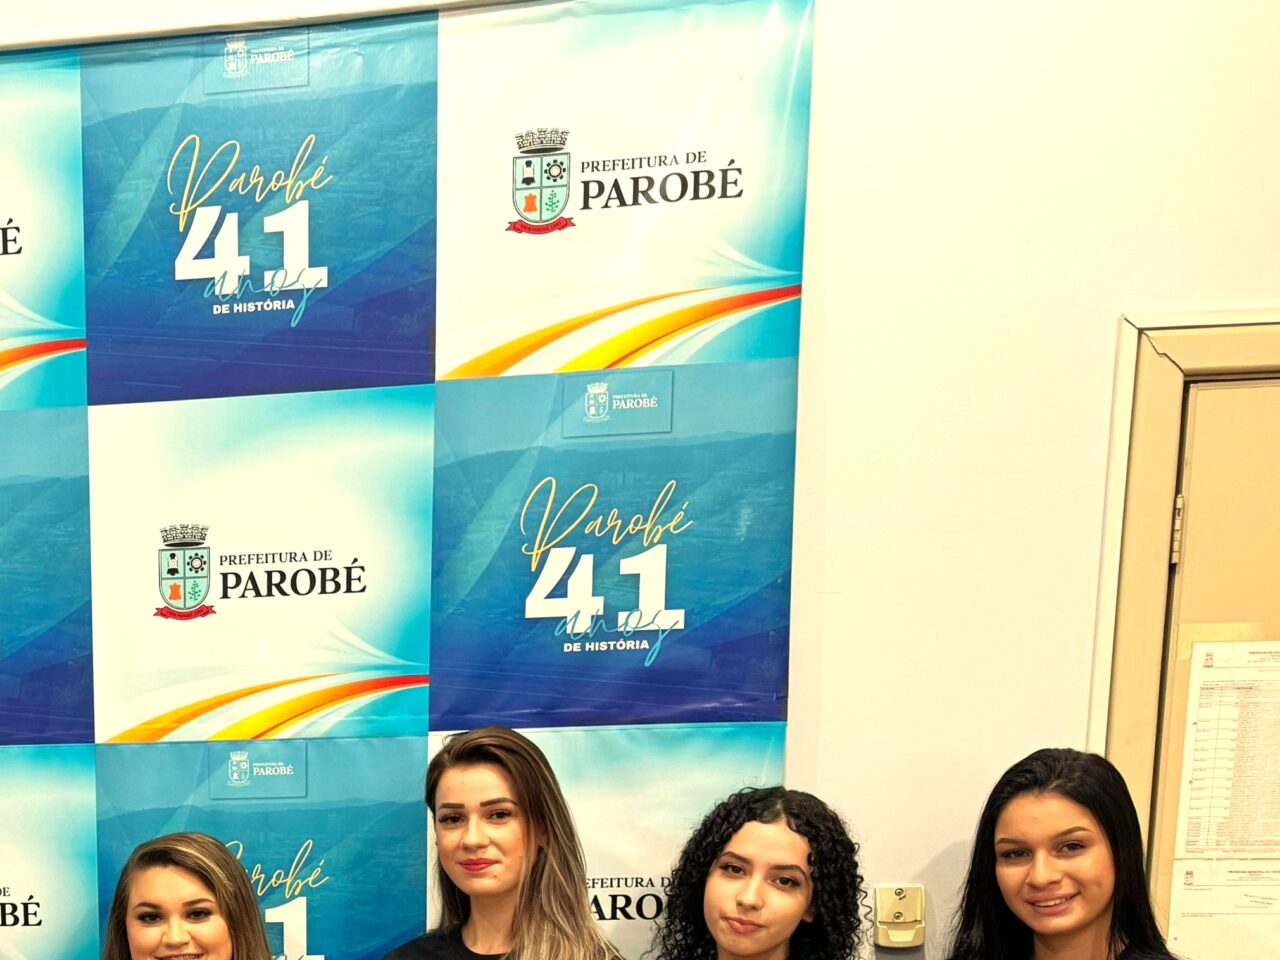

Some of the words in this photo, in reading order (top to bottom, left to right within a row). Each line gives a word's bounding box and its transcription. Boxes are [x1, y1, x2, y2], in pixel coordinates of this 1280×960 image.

[581, 154, 679, 173] PREFEITURA
[685, 150, 707, 164] DE
[167, 134, 333, 232] Parobé
[580, 159, 744, 210] PAROBÉ
[175, 200, 328, 296] 41
[212, 304, 230, 315] DE
[233, 299, 295, 313] HISTÓRIA
[612, 395, 658, 410] PAROBÉ
[520, 476, 694, 572] Parobé
[219, 551, 308, 566] PREFEITURA
[313, 550, 333, 561] DE
[219, 557, 367, 600] PAROBÉ
[525, 544, 686, 635] 41
[563, 642, 581, 652] DE
[585, 639, 650, 651] HISTÓRIA
[253, 765, 294, 776] PAROBÉ
[586, 877, 655, 888] EFEITURA
[660, 877, 672, 888] D
[590, 893, 664, 921] ARO
